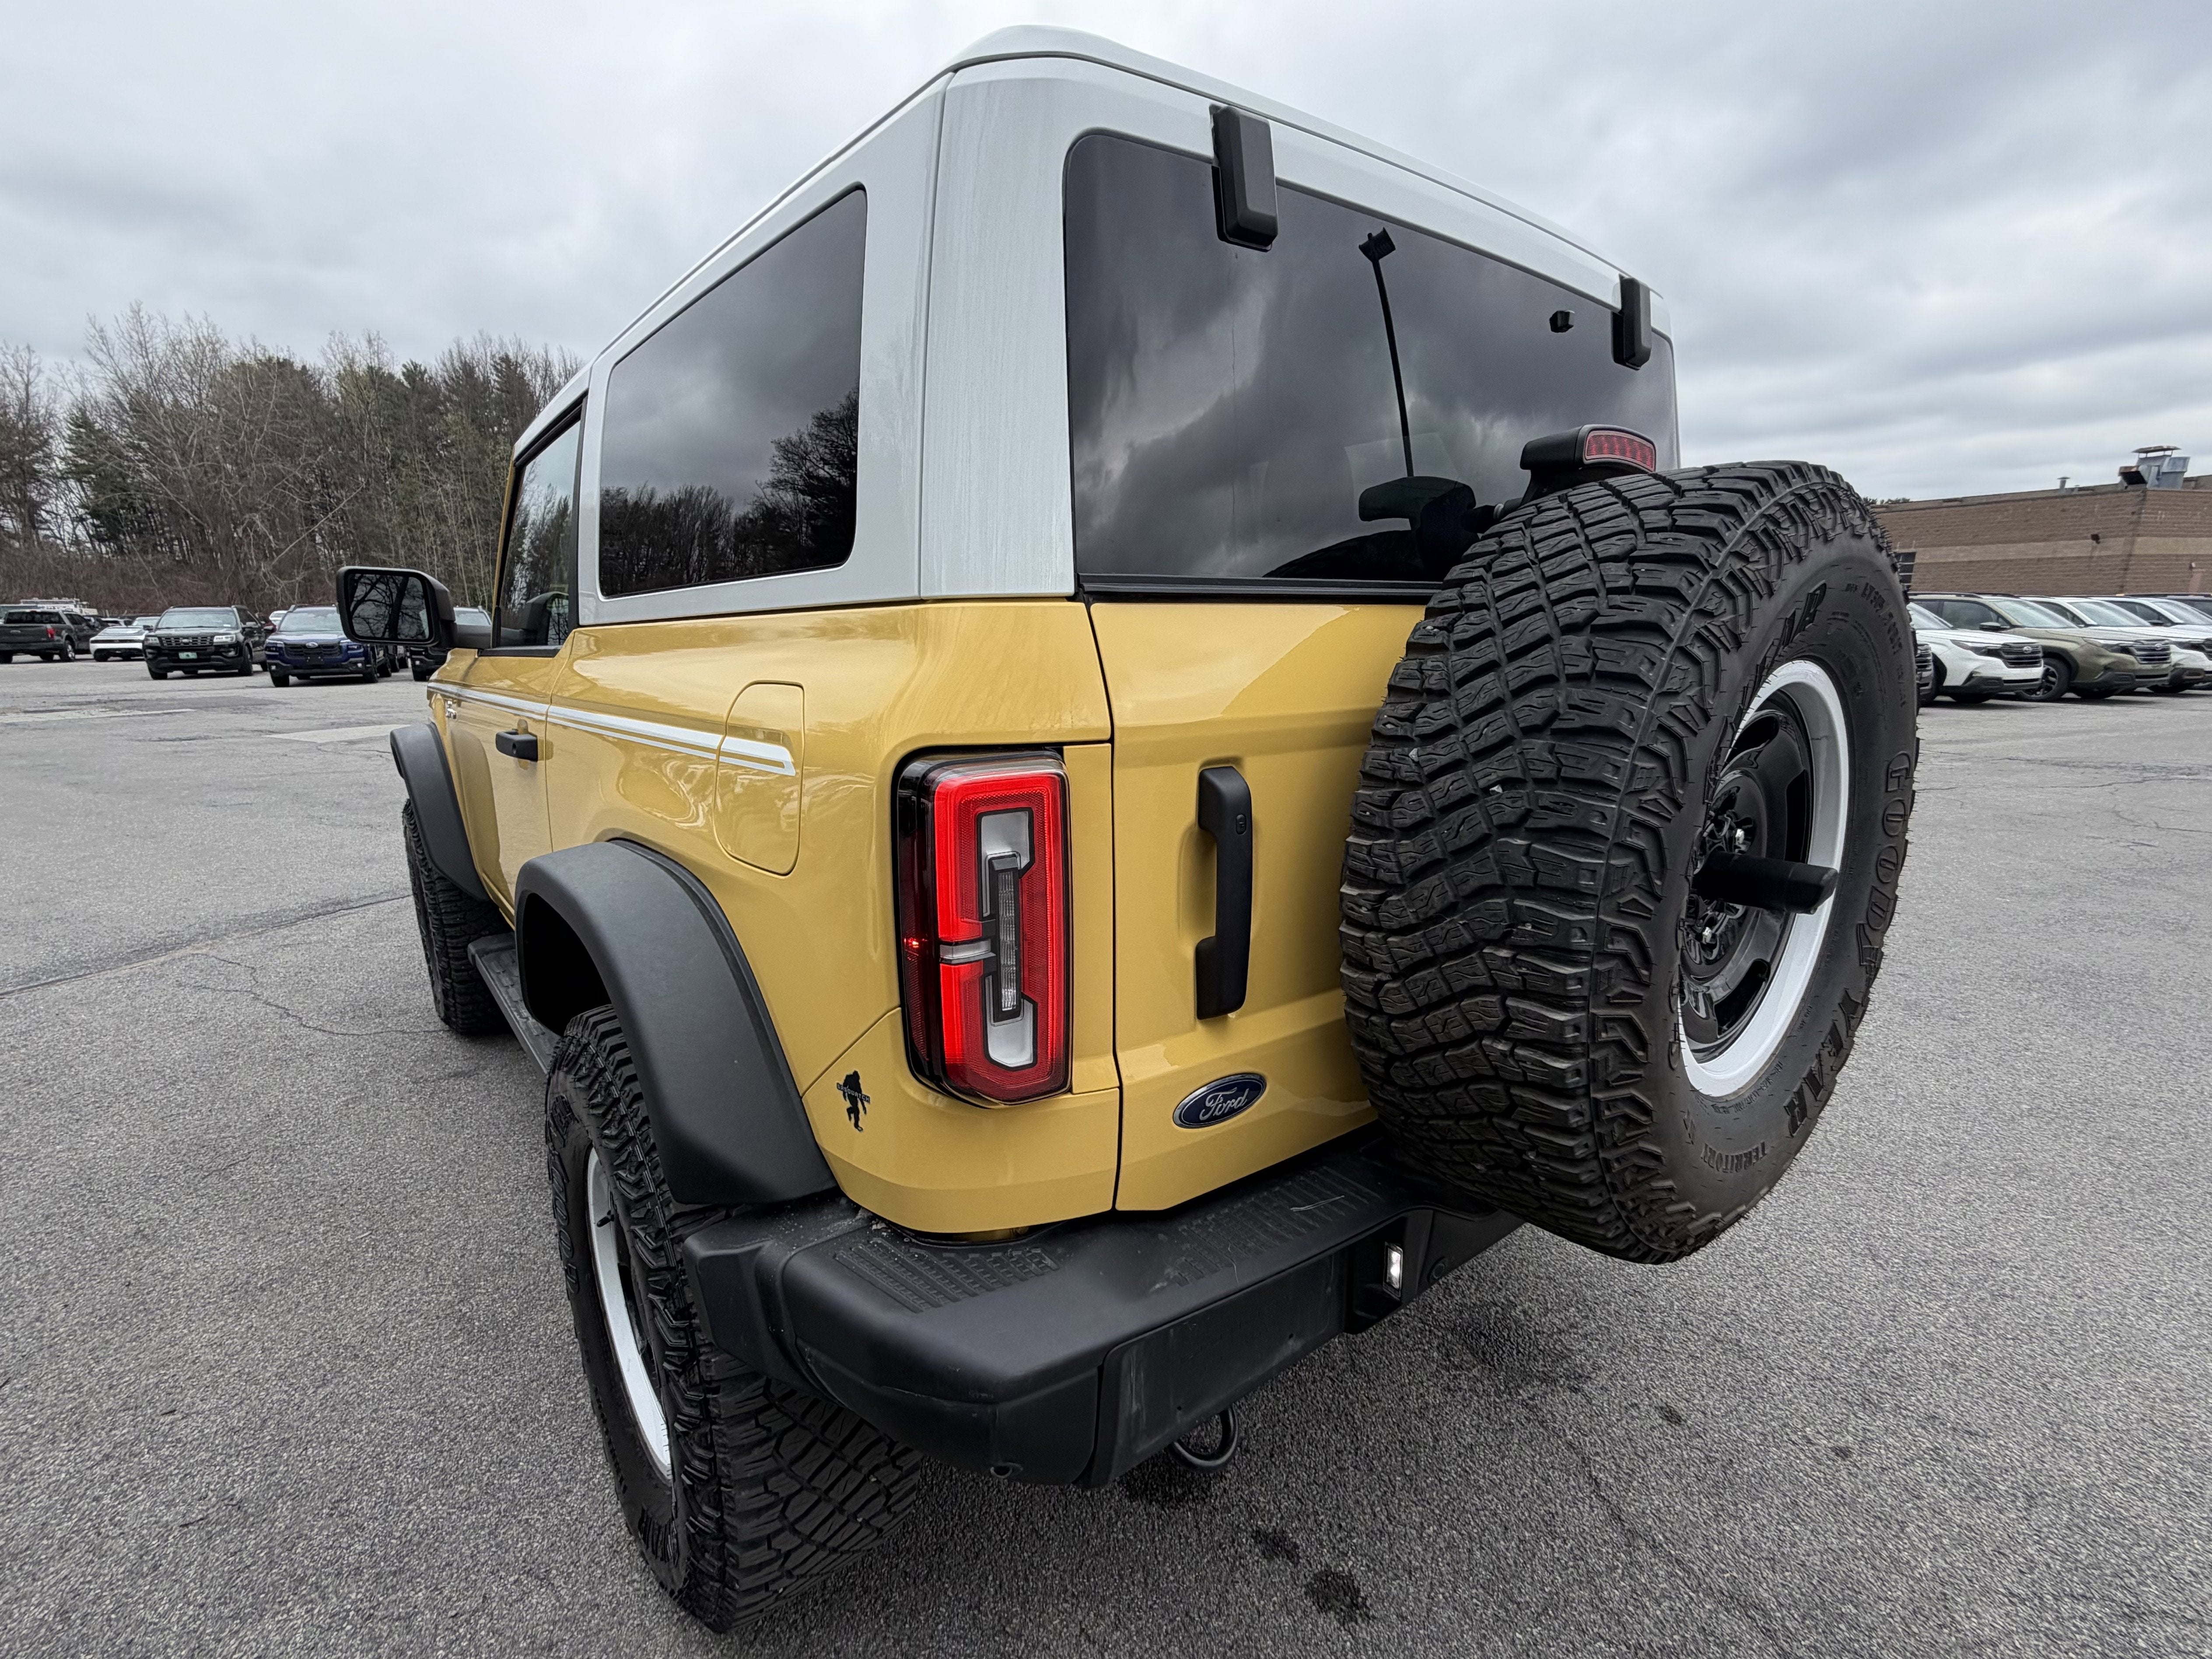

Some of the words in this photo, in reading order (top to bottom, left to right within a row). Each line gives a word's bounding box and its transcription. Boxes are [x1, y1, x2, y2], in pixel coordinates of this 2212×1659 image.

[837, 1084, 869, 1102] SASQUATCH
[1199, 1086, 1250, 1121] Ford
[1701, 1141, 1768, 1173] TERRITORY
